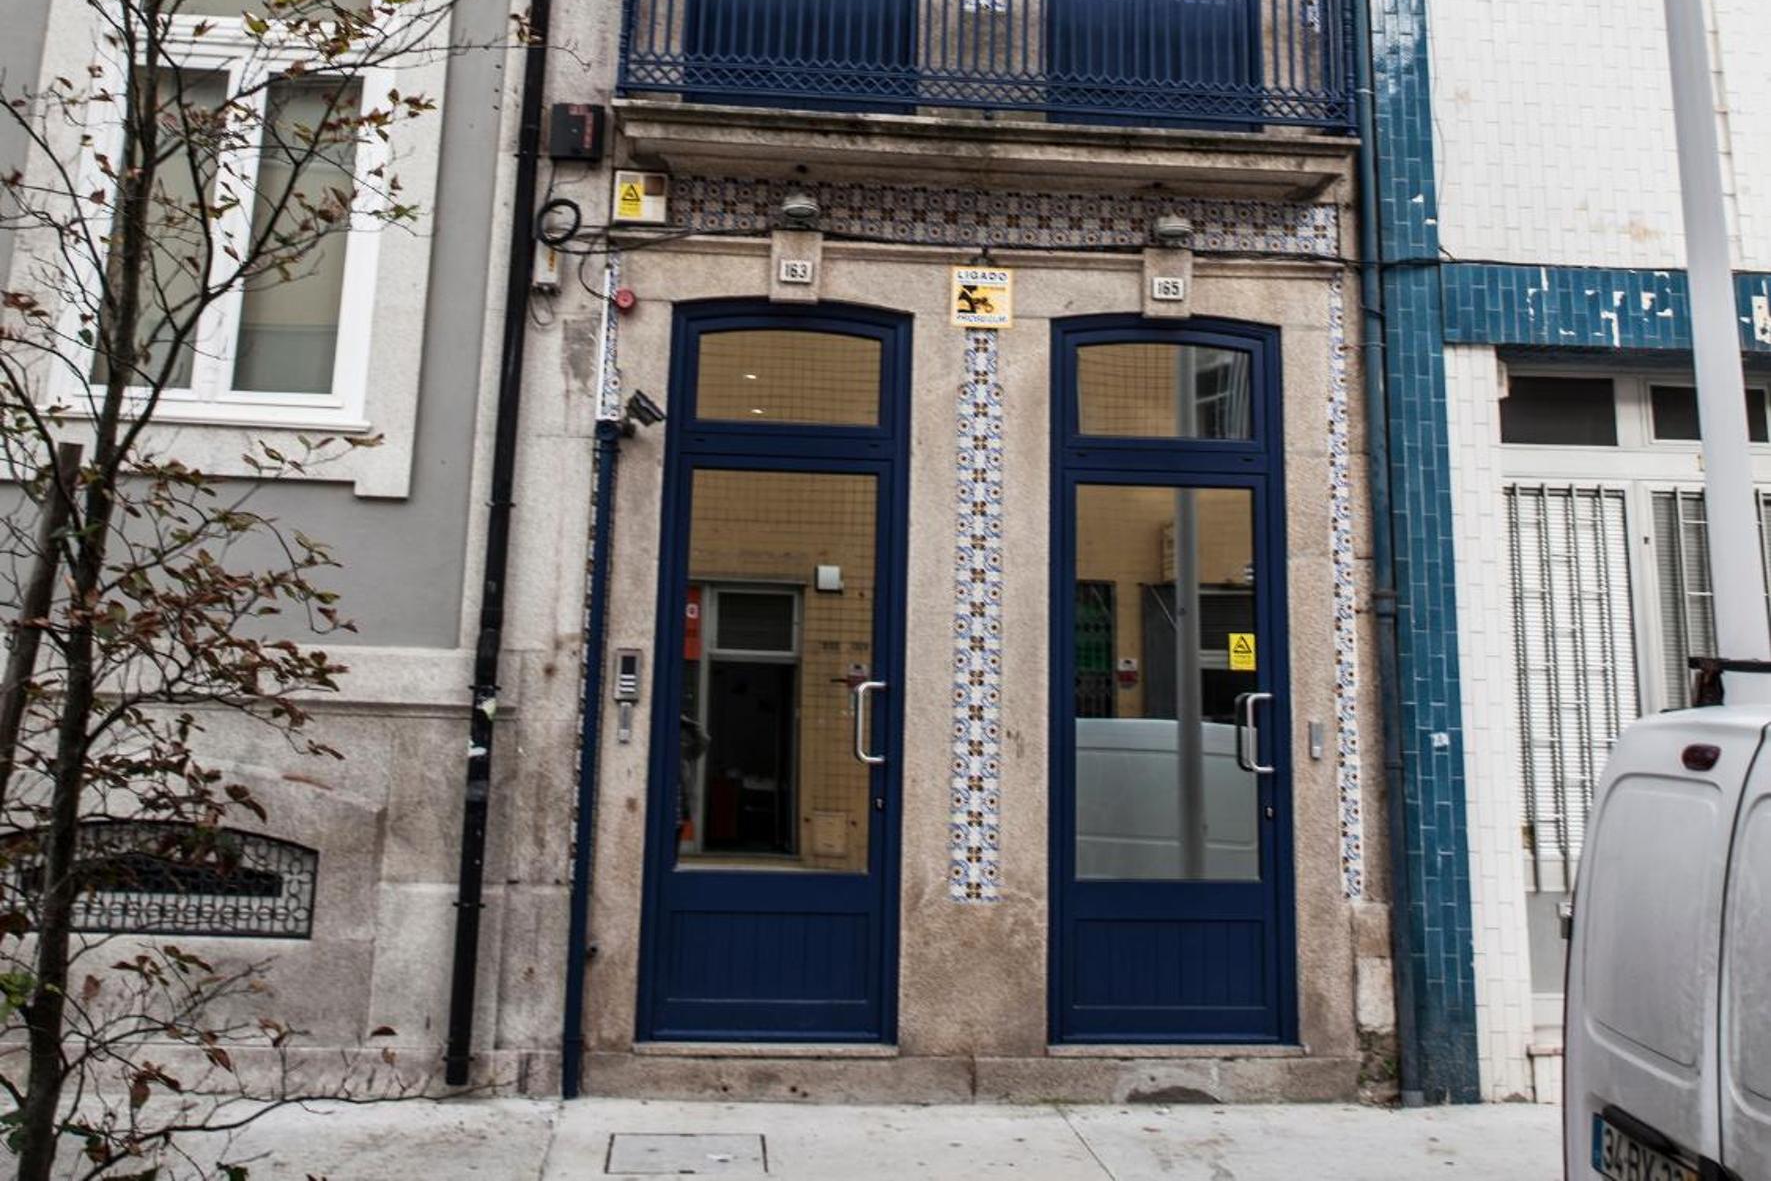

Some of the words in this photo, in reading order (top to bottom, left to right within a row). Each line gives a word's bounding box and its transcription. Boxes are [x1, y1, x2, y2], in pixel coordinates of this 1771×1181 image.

[785, 263, 807, 278] 163
[957, 270, 1007, 281] LIGADO
[1158, 280, 1179, 296] 165
